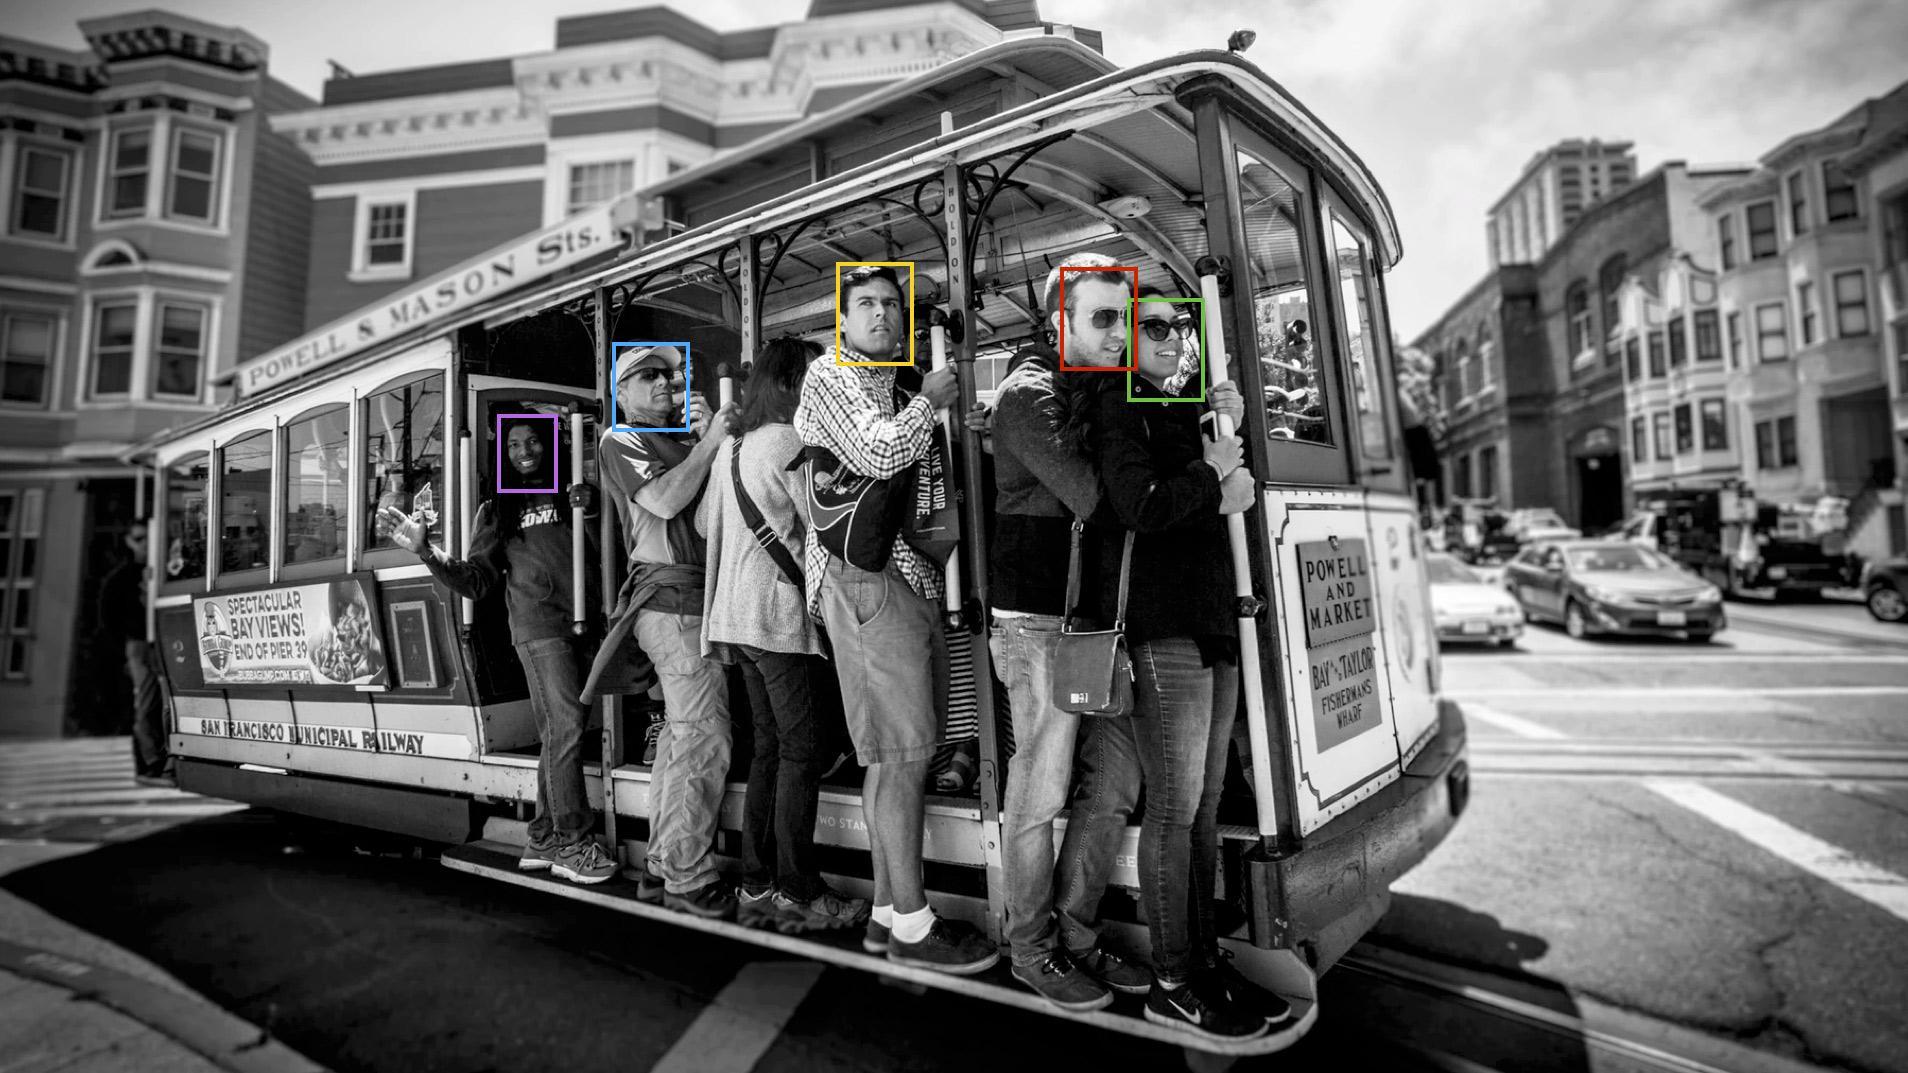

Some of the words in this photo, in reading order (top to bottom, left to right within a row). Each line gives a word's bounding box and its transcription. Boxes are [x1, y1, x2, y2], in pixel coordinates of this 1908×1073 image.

[947, 186, 958, 247] HOLD
[951, 257, 959, 285] ON
[249, 334, 347, 387] POWELL
[357, 319, 375, 342] &
[389, 254, 515, 329] MASON
[536, 226, 601, 266] Sts.
[931, 446, 943, 476] LIVE
[916, 451, 931, 519] DVENTURE.
[933, 477, 946, 510] YOUR
[1306, 555, 1368, 583] POWELL
[227, 591, 302, 616] SPECTACULAR
[1326, 581, 1356, 601] AND
[231, 616, 254, 640] BAY
[255, 612, 306, 638] VIEWS!
[1309, 598, 1372, 630] MARKET
[234, 642, 254, 661] END
[255, 641, 268, 660] OF
[270, 641, 293, 659] PIER
[295, 640, 308, 659] 39
[1312, 660, 1330, 690] BAY
[1338, 647, 1374, 680] TAYLOR
[1321, 679, 1372, 716] FISHERMANS
[201, 719, 221, 736] SAN
[1336, 703, 1362, 730] WHARF
